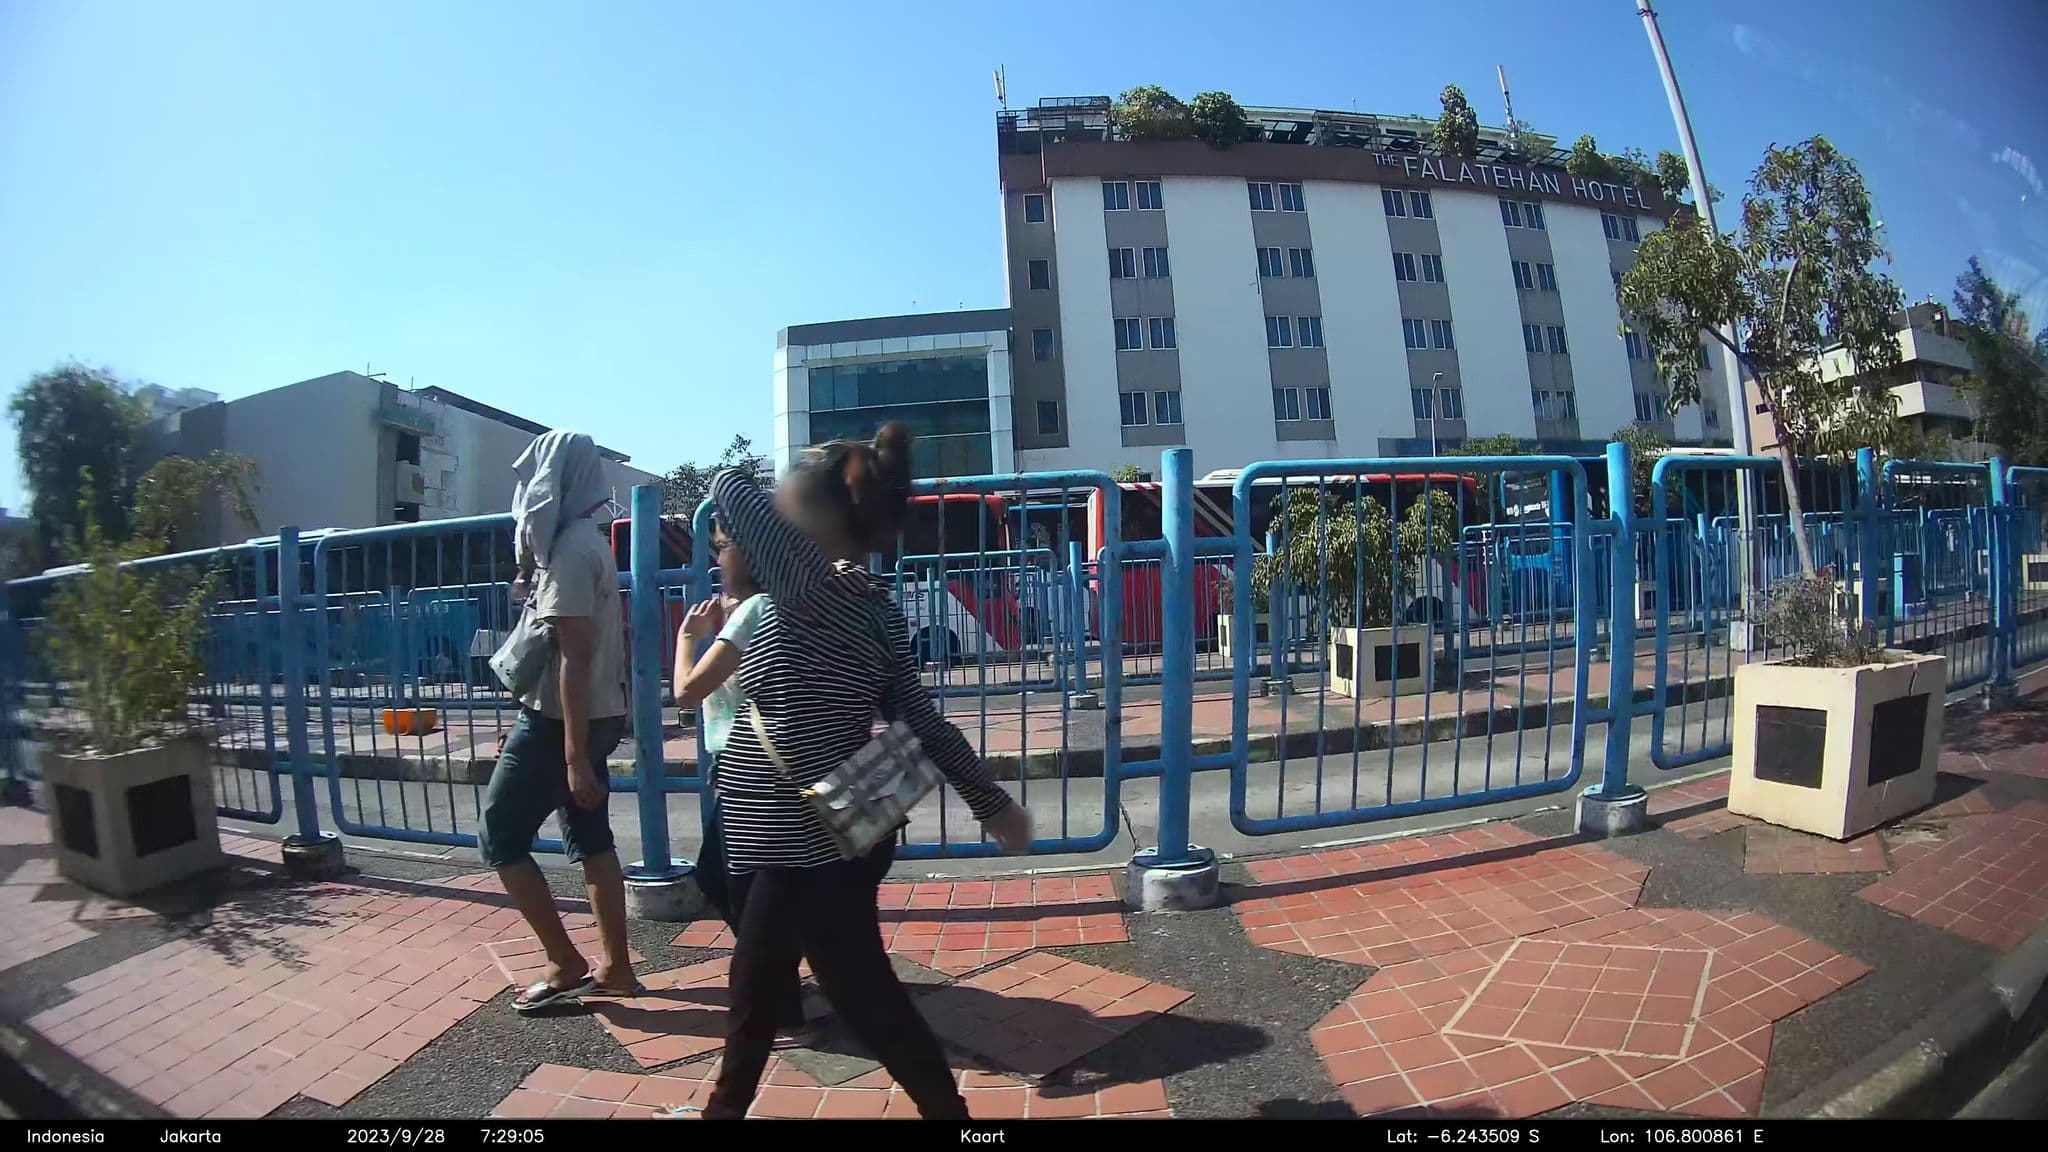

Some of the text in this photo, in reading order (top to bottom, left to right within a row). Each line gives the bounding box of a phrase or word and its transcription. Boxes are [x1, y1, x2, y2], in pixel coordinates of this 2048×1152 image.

[1371, 153, 1652, 209] THE FALATEHAN HOTEL
